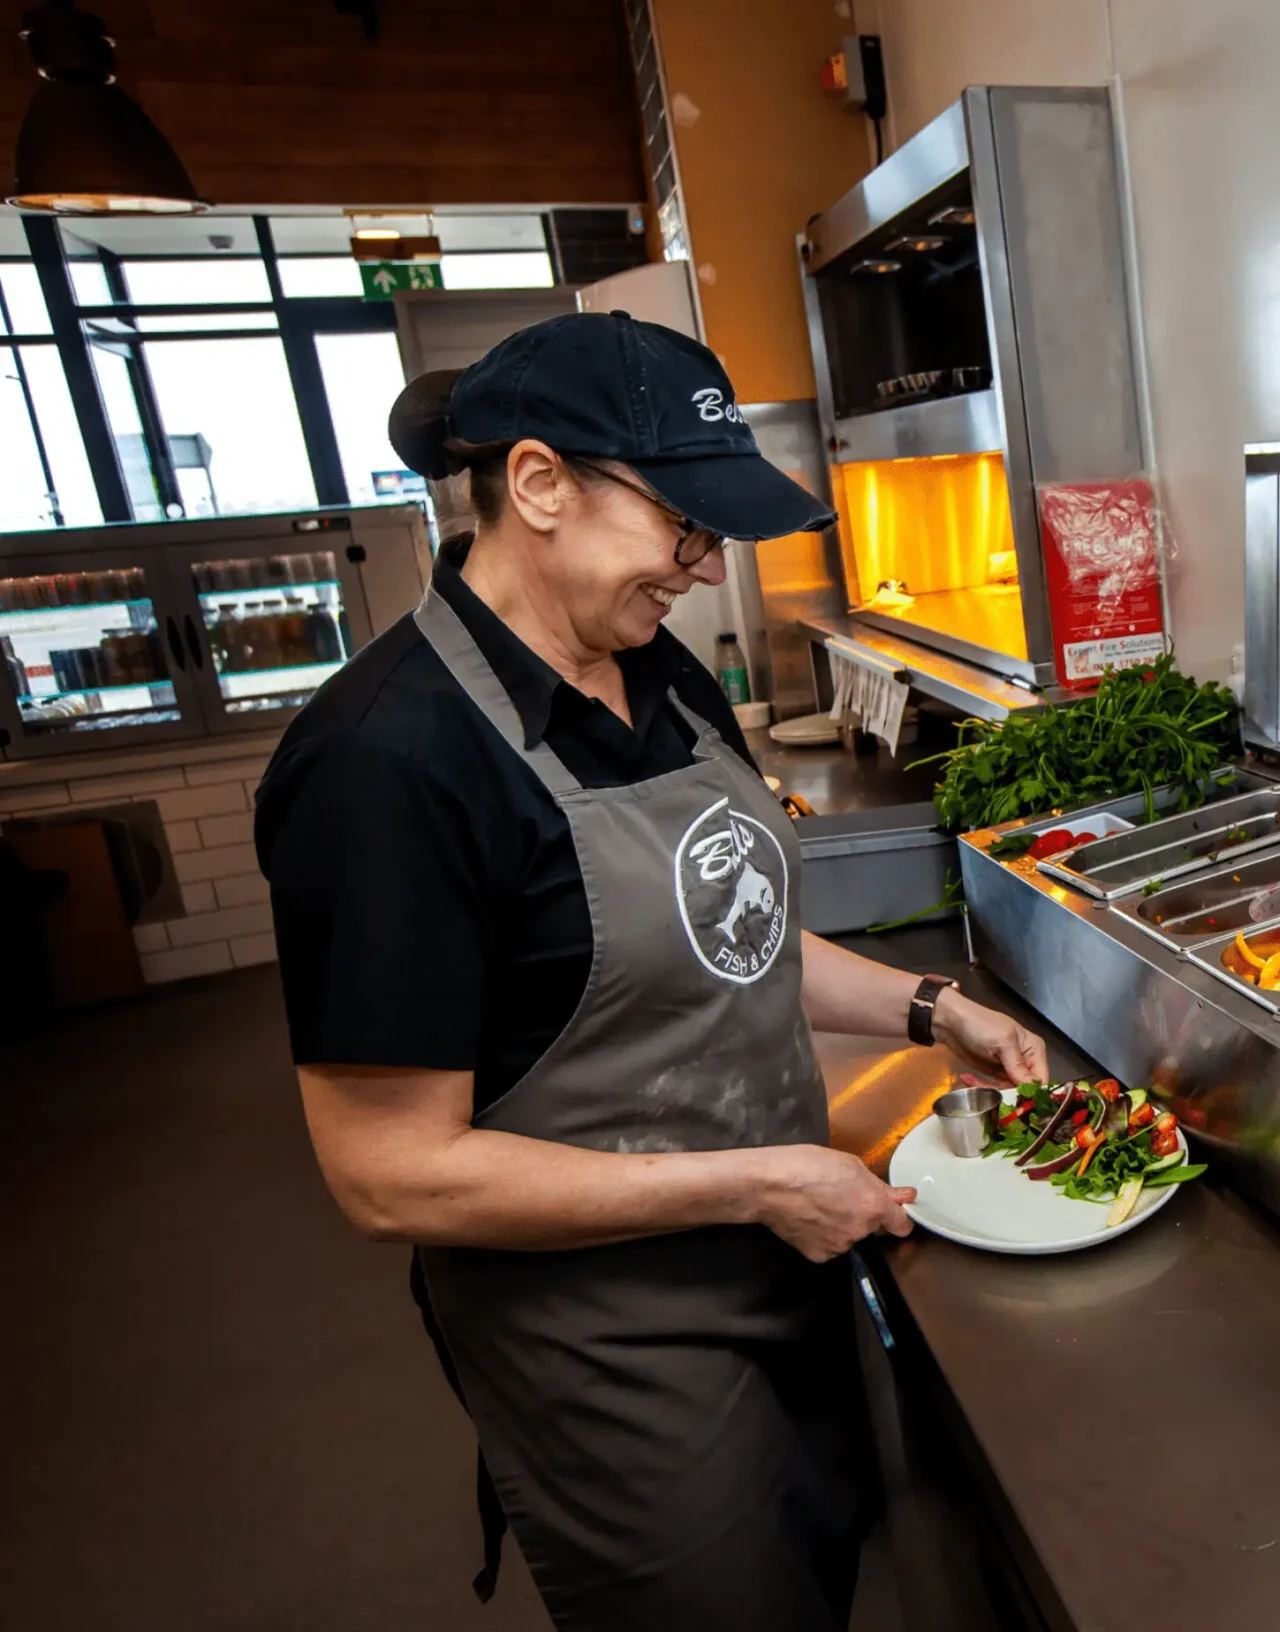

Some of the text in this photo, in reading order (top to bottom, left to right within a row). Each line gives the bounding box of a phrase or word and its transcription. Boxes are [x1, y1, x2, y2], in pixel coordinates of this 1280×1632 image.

[1100, 643, 1117, 652] Fire
[1119, 638, 1162, 650] Solutions
[714, 904, 783, 975] FISH & CHIPS
